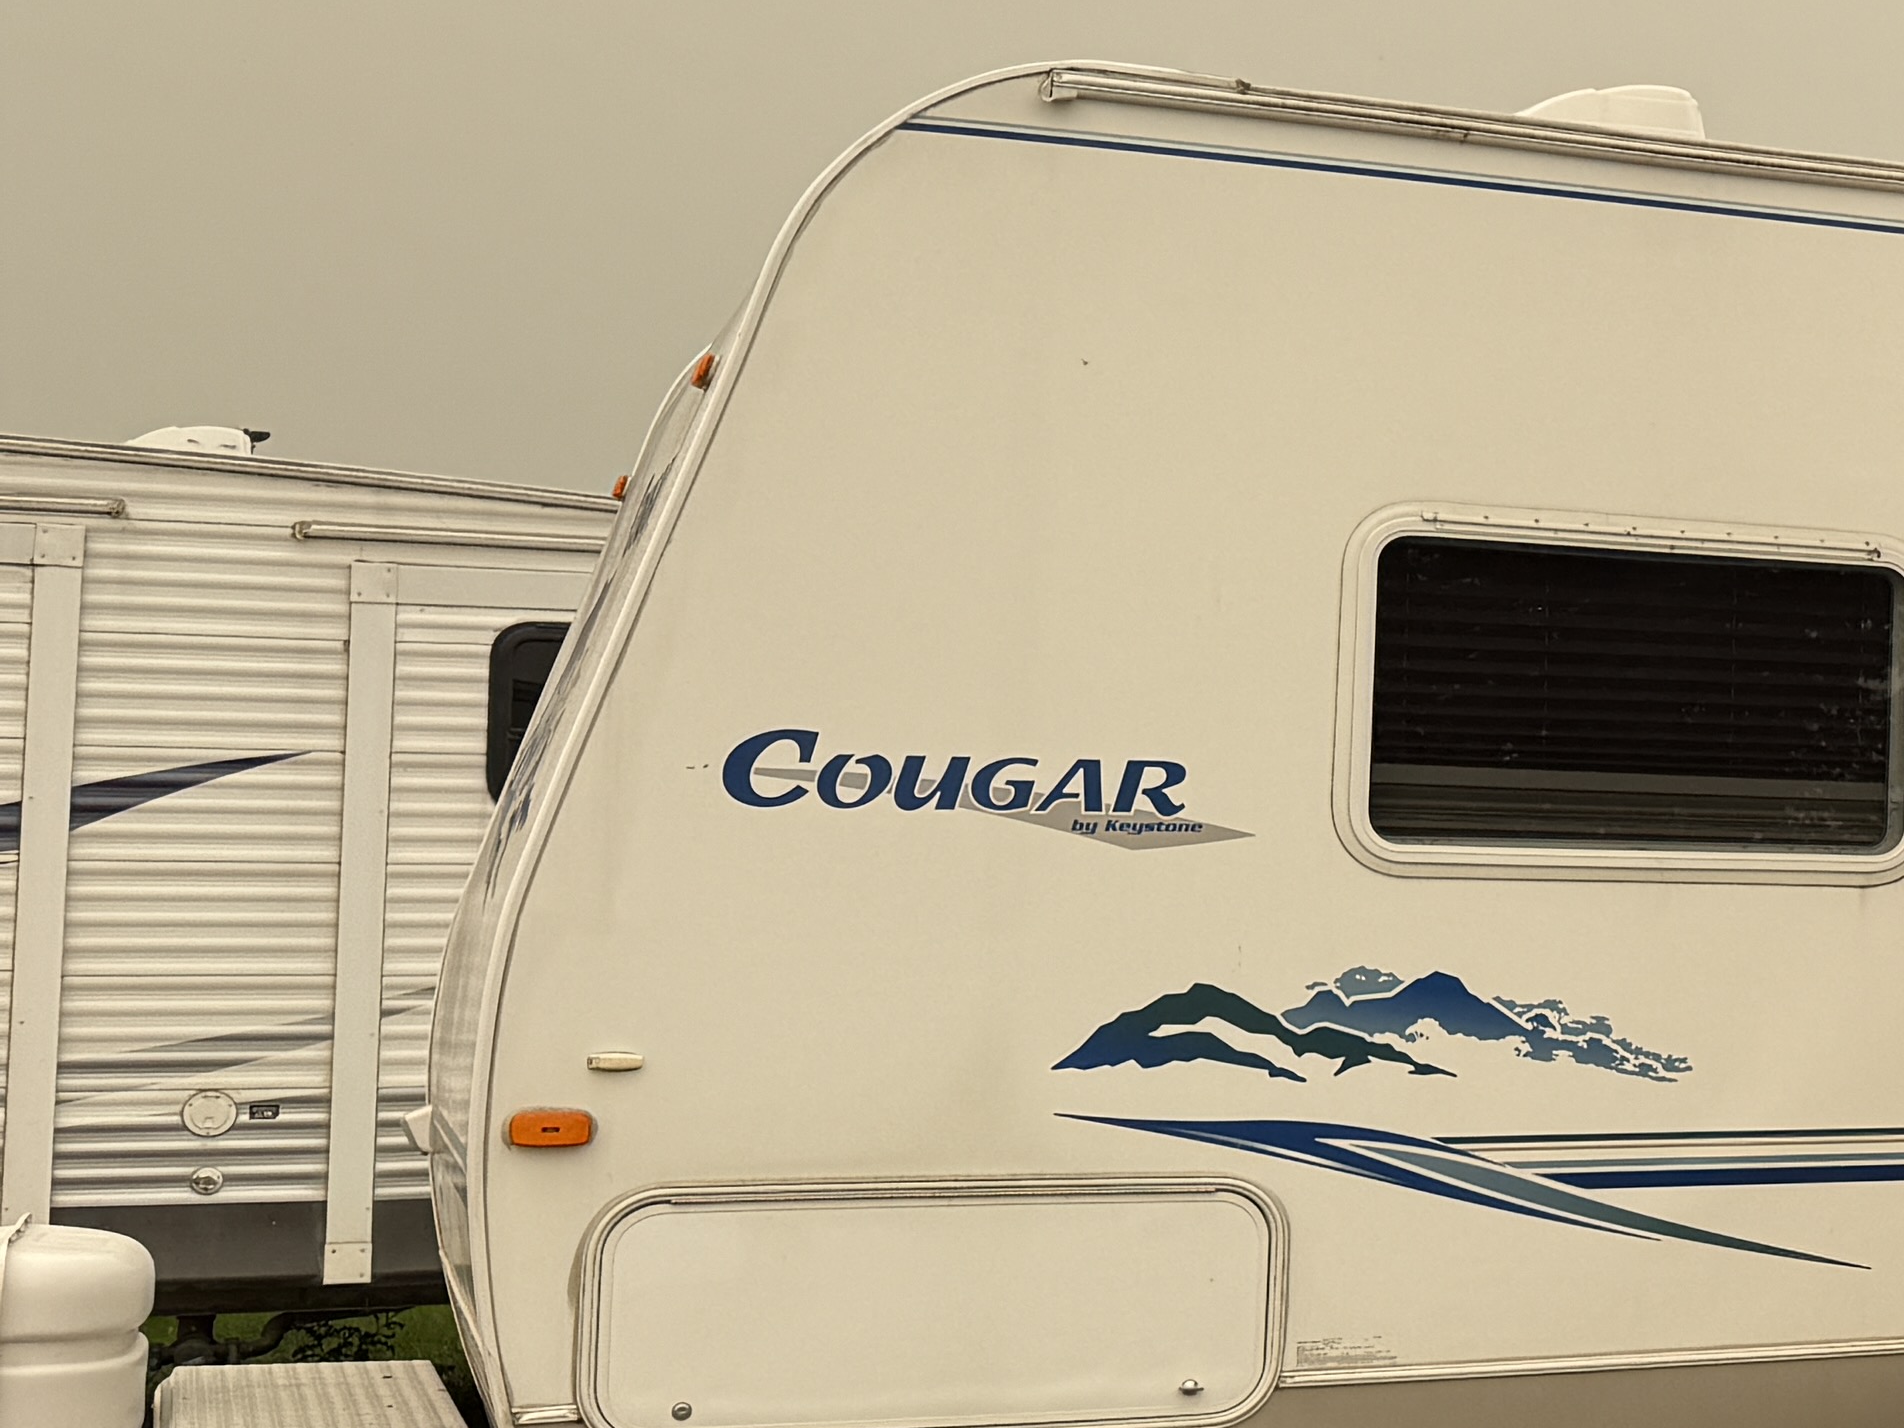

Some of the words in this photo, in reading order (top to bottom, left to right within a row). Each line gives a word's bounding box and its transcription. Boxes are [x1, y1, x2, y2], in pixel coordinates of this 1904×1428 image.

[721, 728, 1187, 818] COUGAR
[1071, 819, 1098, 835] by
[1104, 819, 1204, 835] Keystone
